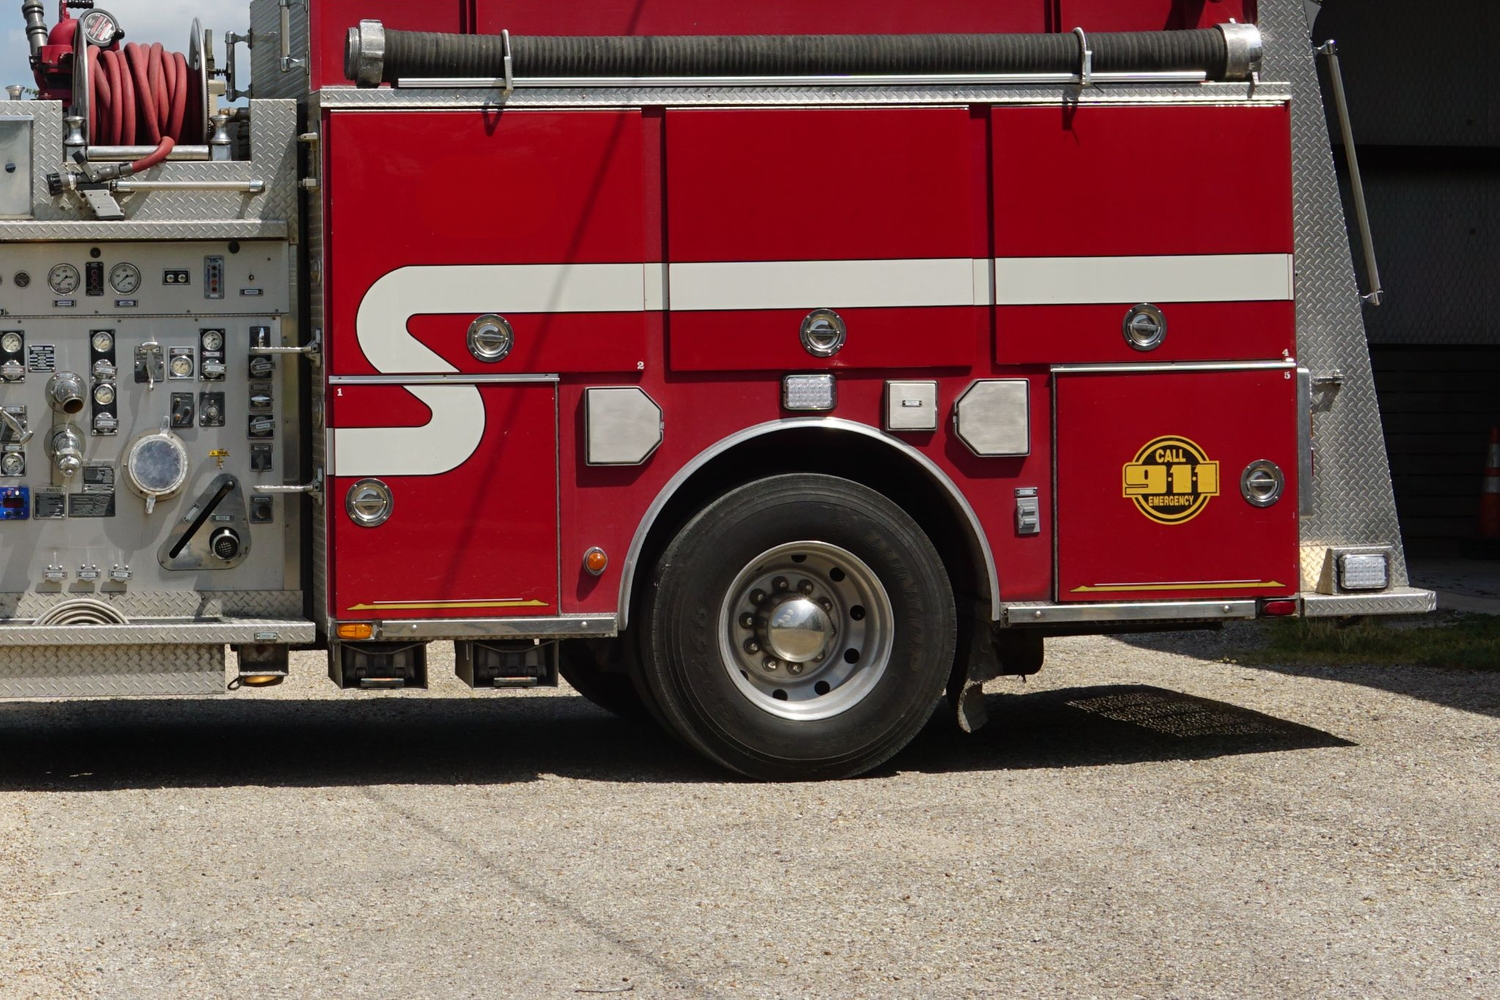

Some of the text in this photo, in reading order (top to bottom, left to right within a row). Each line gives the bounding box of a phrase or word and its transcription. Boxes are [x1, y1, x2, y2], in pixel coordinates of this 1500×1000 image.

[1282, 348, 1289, 357] 4
[636, 361, 644, 370] 2
[1284, 371, 1291, 379] 5
[337, 387, 343, 396] 1
[1155, 449, 1187, 463] CALL
[1148, 495, 1194, 506] EMERGENCY
